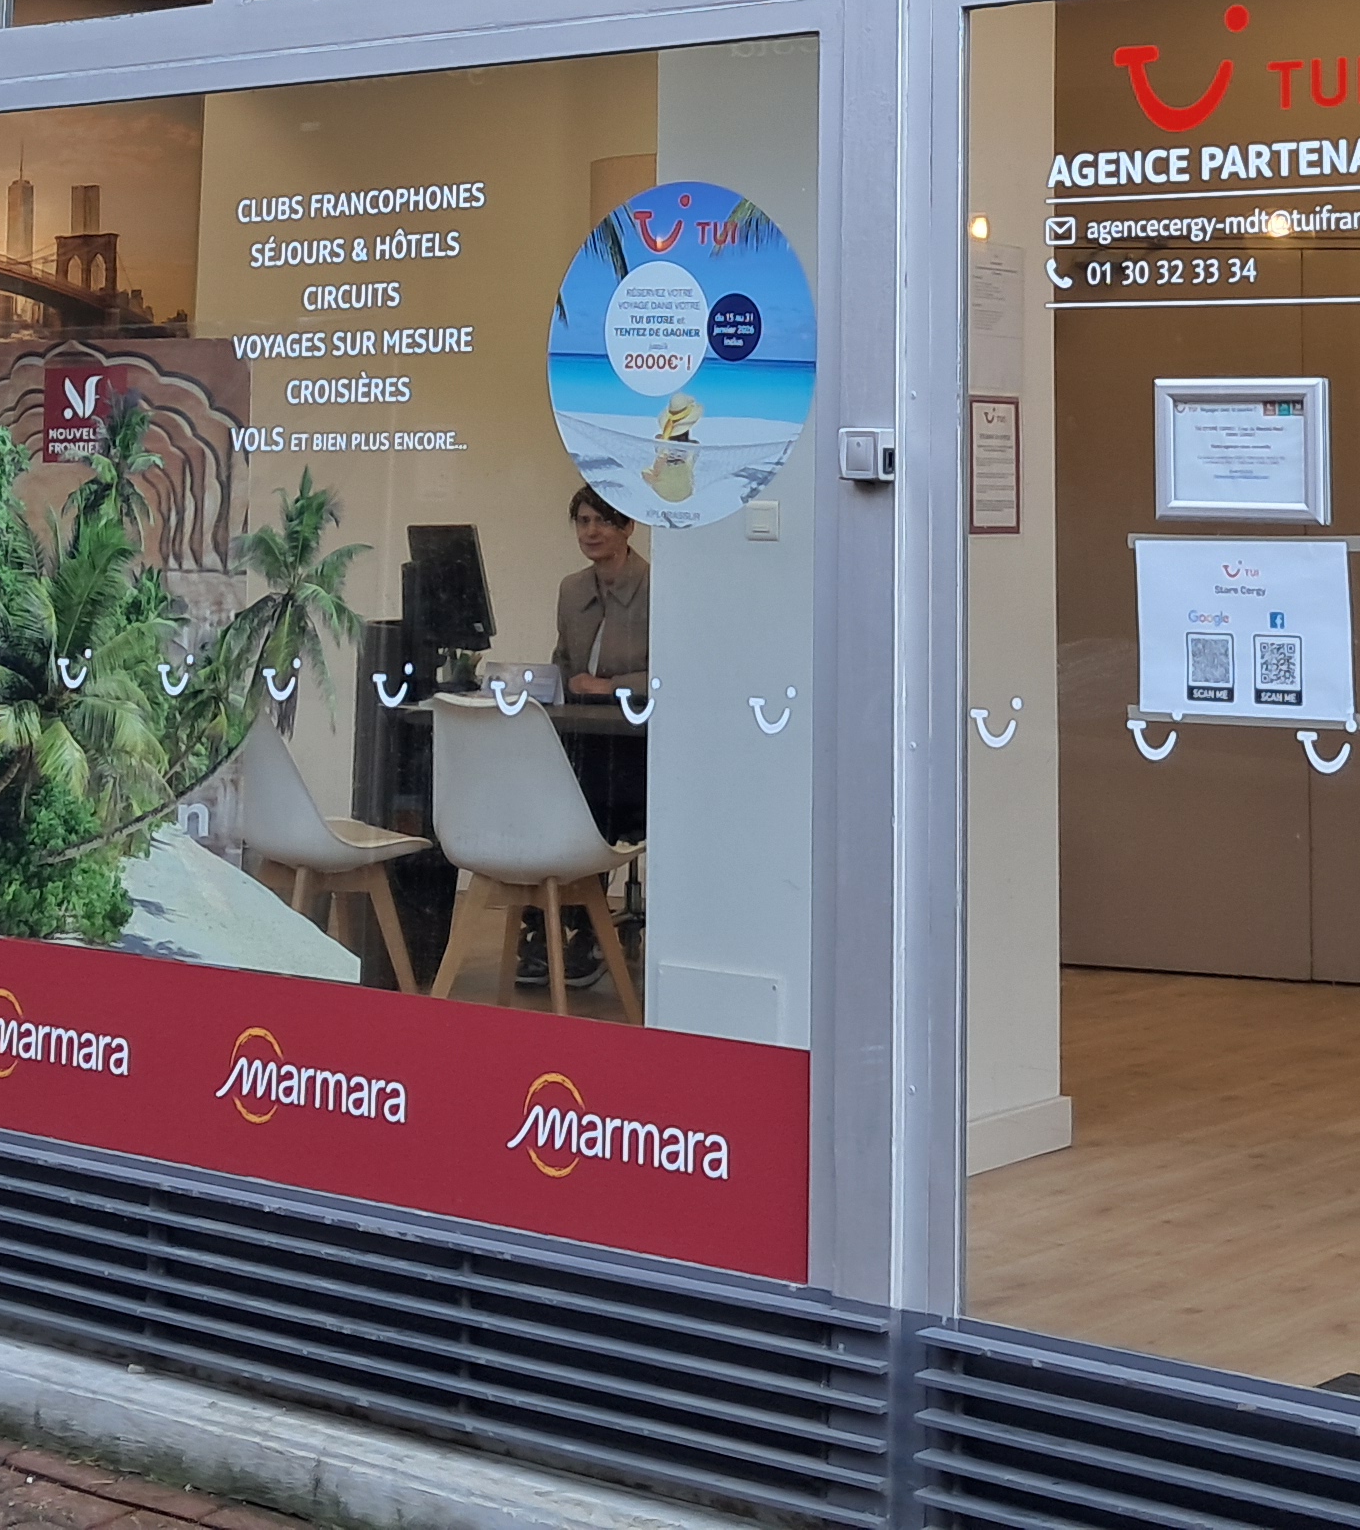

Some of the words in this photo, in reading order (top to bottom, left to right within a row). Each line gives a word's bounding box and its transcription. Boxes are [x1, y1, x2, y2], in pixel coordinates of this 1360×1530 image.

[1047, 147, 1190, 188] AGENCE
[237, 195, 304, 223] CLUBS
[310, 182, 485, 218] FRANCOPHONES
[695, 221, 739, 245] TUI
[250, 236, 345, 268] SÉJOURS
[351, 238, 368, 261] &
[375, 228, 460, 261] HÔTELS
[1086, 261, 1112, 286] 01
[1121, 260, 1148, 285] 30
[1156, 259, 1184, 285] 32
[1191, 258, 1218, 284] 33
[1228, 256, 1256, 283] 34
[303, 282, 400, 311] CIRCUITS
[233, 332, 326, 360] VOYAGES
[332, 331, 376, 356] SUR
[383, 326, 473, 355] MESURE
[614, 327, 646, 337] TENTEZ
[649, 327, 661, 337] DE
[663, 328, 700, 338] GAGNER
[286, 371, 411, 404] CROISIÈRES
[231, 427, 284, 452] VOLS
[290, 433, 309, 451] ET
[313, 433, 346, 451] BIEN
[351, 433, 390, 451] PLUS
[1244, 567, 1260, 578] TUI
[1214, 585, 1239, 596] Store
[1240, 585, 1267, 597] Cergy
[1188, 609, 1229, 627] Google
[1192, 689, 1216, 700] SCAN
[1218, 689, 1229, 700] ME
[1260, 692, 1284, 703] SCAN
[1285, 692, 1297, 703] ME
[215, 1056, 407, 1125] Marmara
[506, 1103, 730, 1181] Marmara
